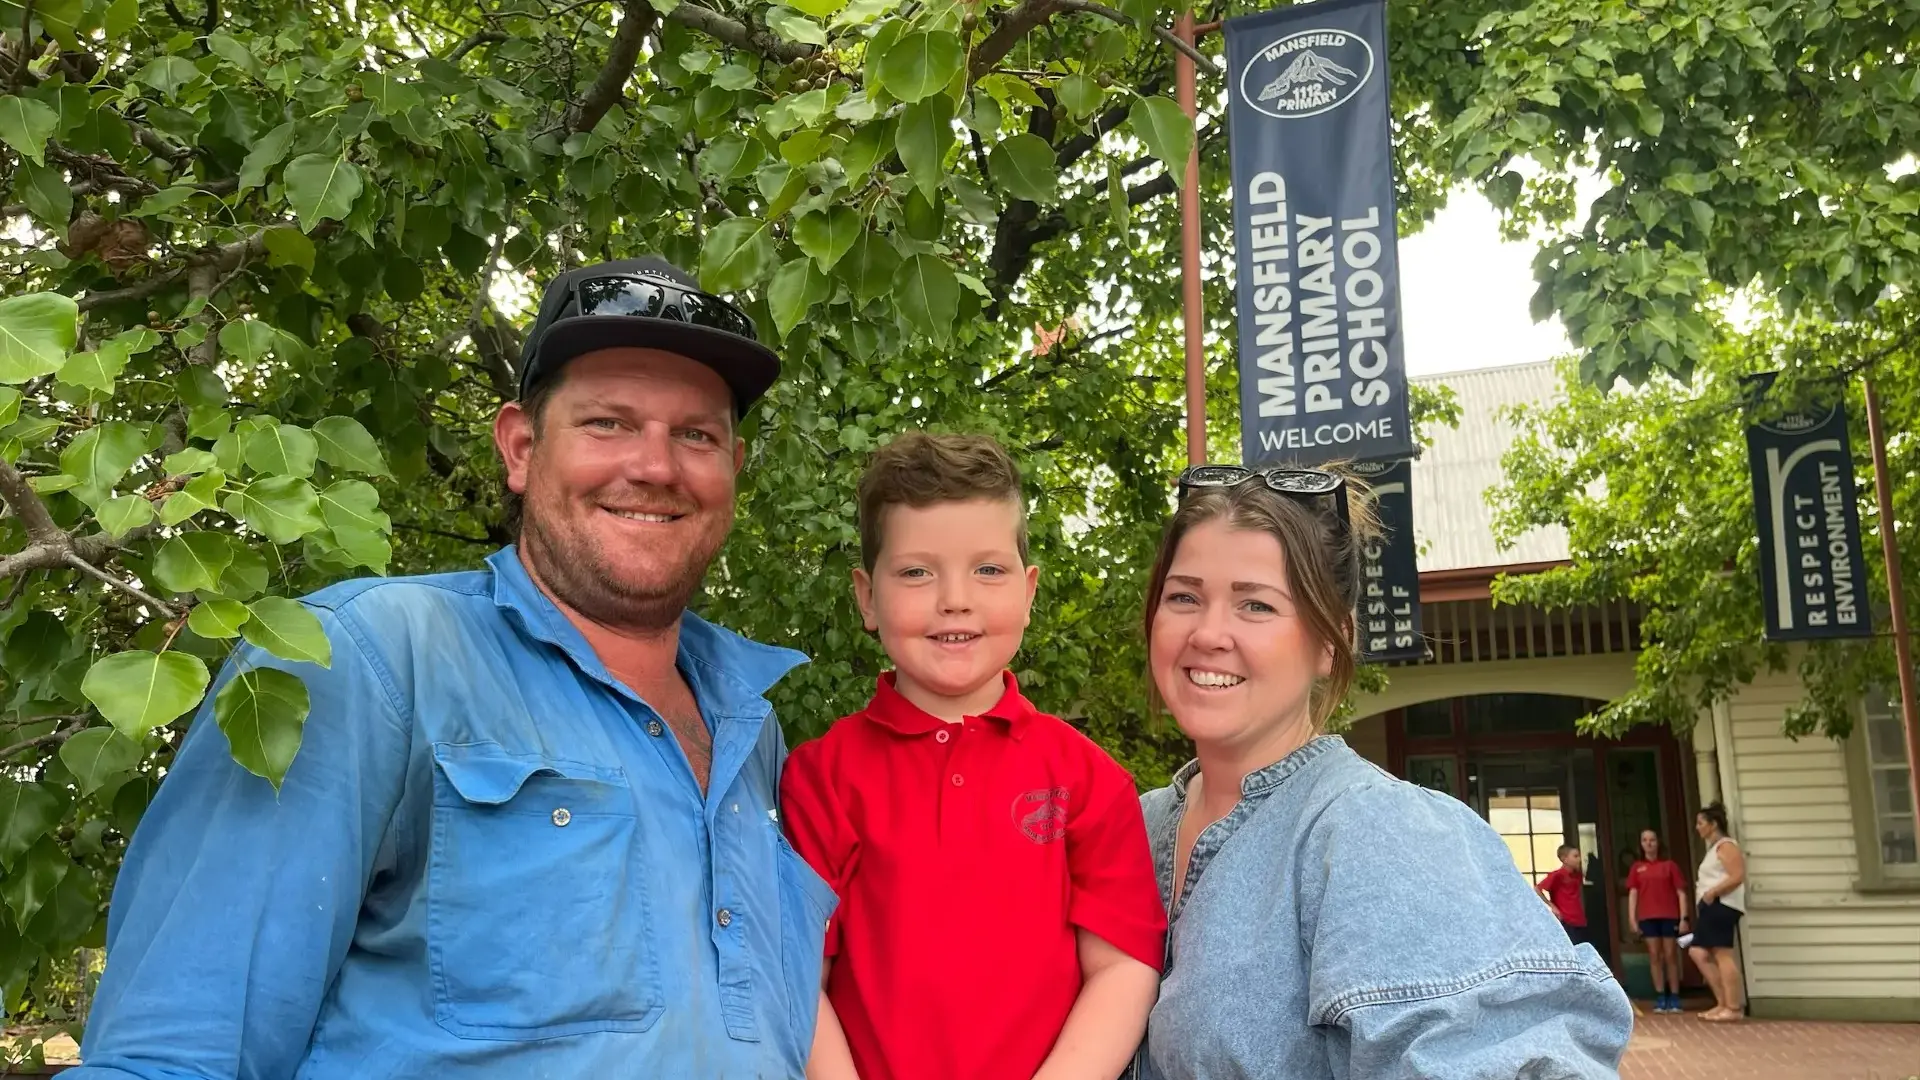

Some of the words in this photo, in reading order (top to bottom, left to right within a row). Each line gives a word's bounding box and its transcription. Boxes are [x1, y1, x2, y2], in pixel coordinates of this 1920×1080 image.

[1264, 34, 1346, 62] MANSFIELD
[1277, 88, 1337, 110] PRIMARY
[1292, 83, 1322, 99] 1112
[1249, 171, 1297, 418] MANSFIELD
[1295, 213, 1343, 413] PRIMARY
[1341, 206, 1391, 406] SCHOOL
[1259, 417, 1393, 452] WELCOME
[1794, 494, 1828, 626] RESPECT
[1818, 462, 1857, 625] ENVIRONMENT
[1364, 545, 1387, 651] RESPEC
[1392, 586, 1413, 648] SELF
